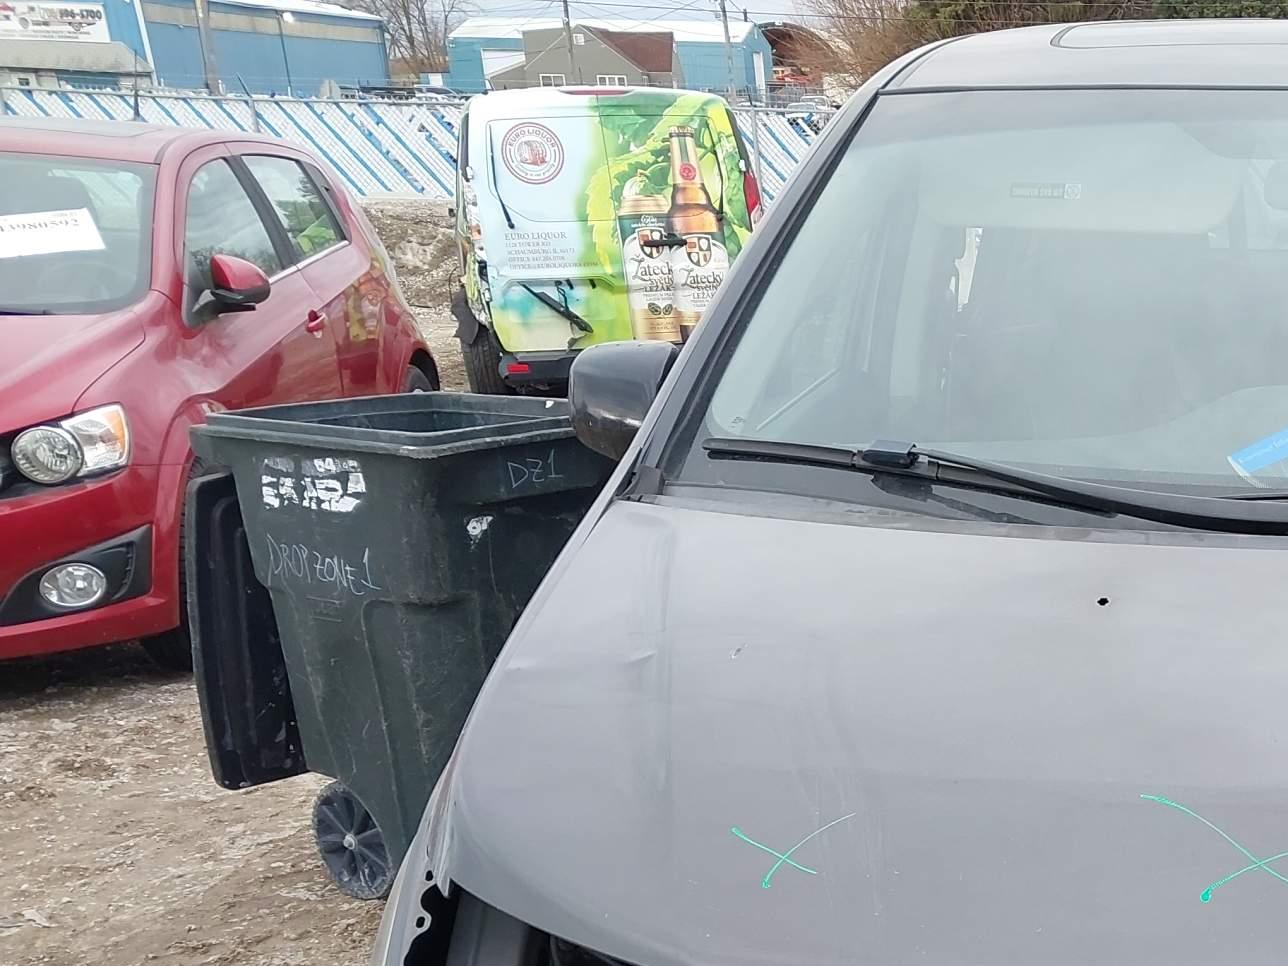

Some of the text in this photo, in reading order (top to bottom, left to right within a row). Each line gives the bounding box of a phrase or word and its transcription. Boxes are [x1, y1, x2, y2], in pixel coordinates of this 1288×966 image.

[507, 128, 557, 148] EURO LIQUOR
[504, 231, 568, 241] EURO LIQUOR
[507, 448, 564, 488] DZ1
